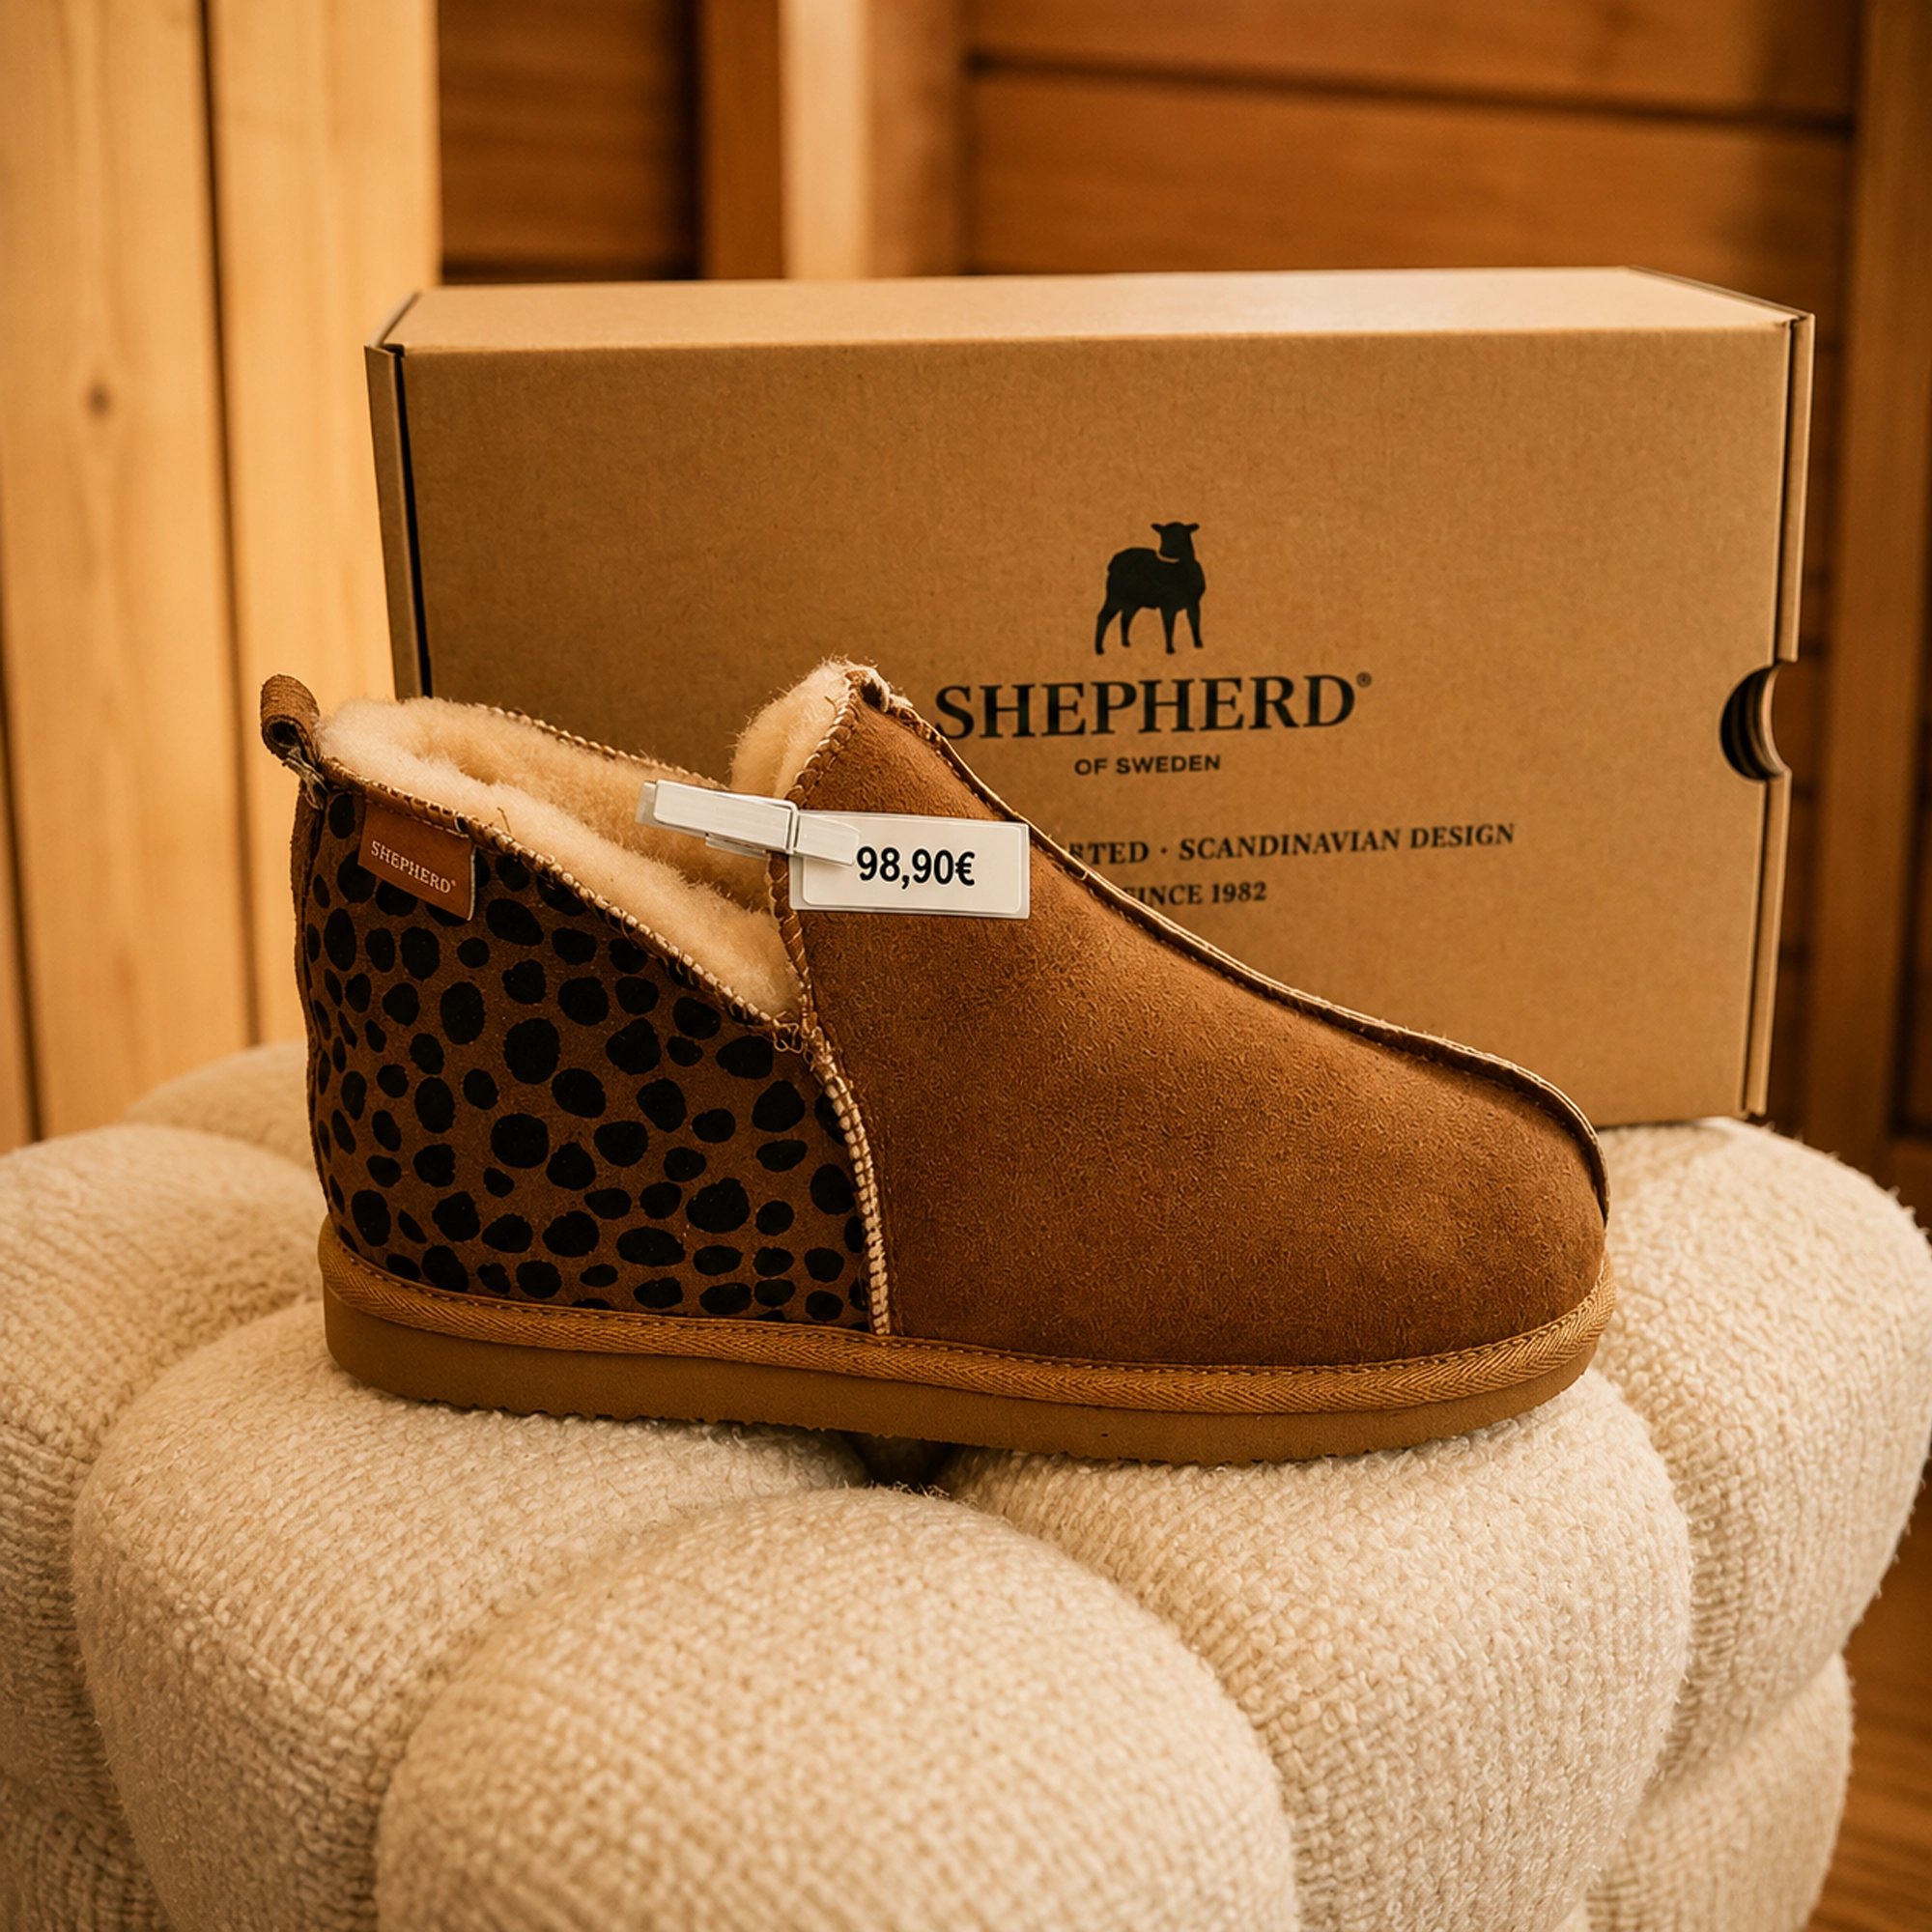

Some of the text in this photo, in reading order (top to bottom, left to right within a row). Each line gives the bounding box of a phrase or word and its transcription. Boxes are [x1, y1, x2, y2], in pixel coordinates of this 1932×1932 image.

[1074, 754, 1221, 776] OF SWEDEN
[1179, 828, 1401, 861] SCANDINAVIAN
[1410, 823, 1515, 849] DESIGN
[856, 846, 976, 890] 98,90€
[1211, 881, 1267, 903] 1982
